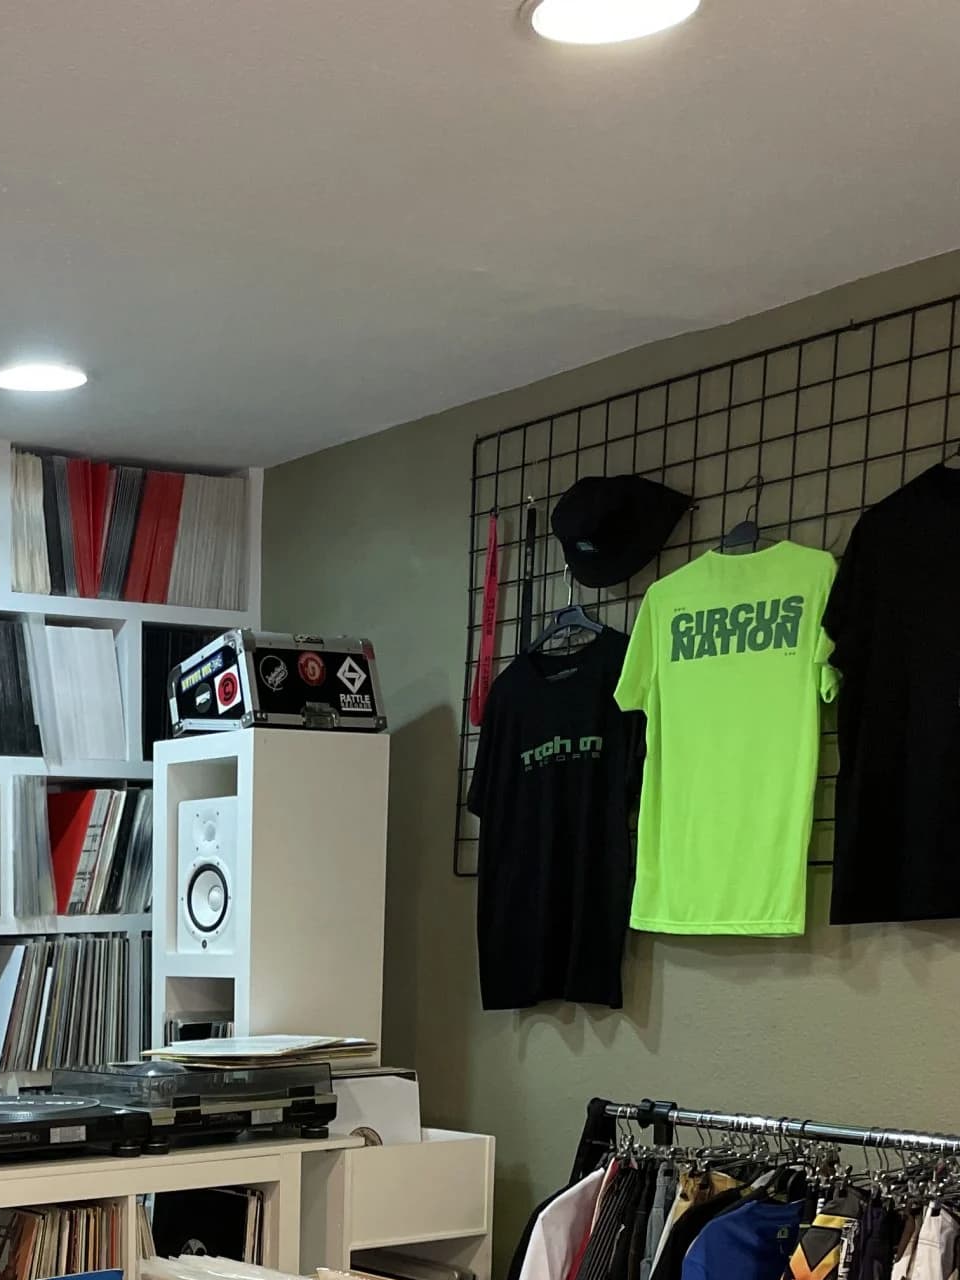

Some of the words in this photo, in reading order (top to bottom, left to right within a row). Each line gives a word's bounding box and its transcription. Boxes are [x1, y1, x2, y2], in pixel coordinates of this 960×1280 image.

[671, 595, 804, 637] CIRCUS
[671, 613, 801, 662] NATION
[339, 693, 371, 704] RATTLE
